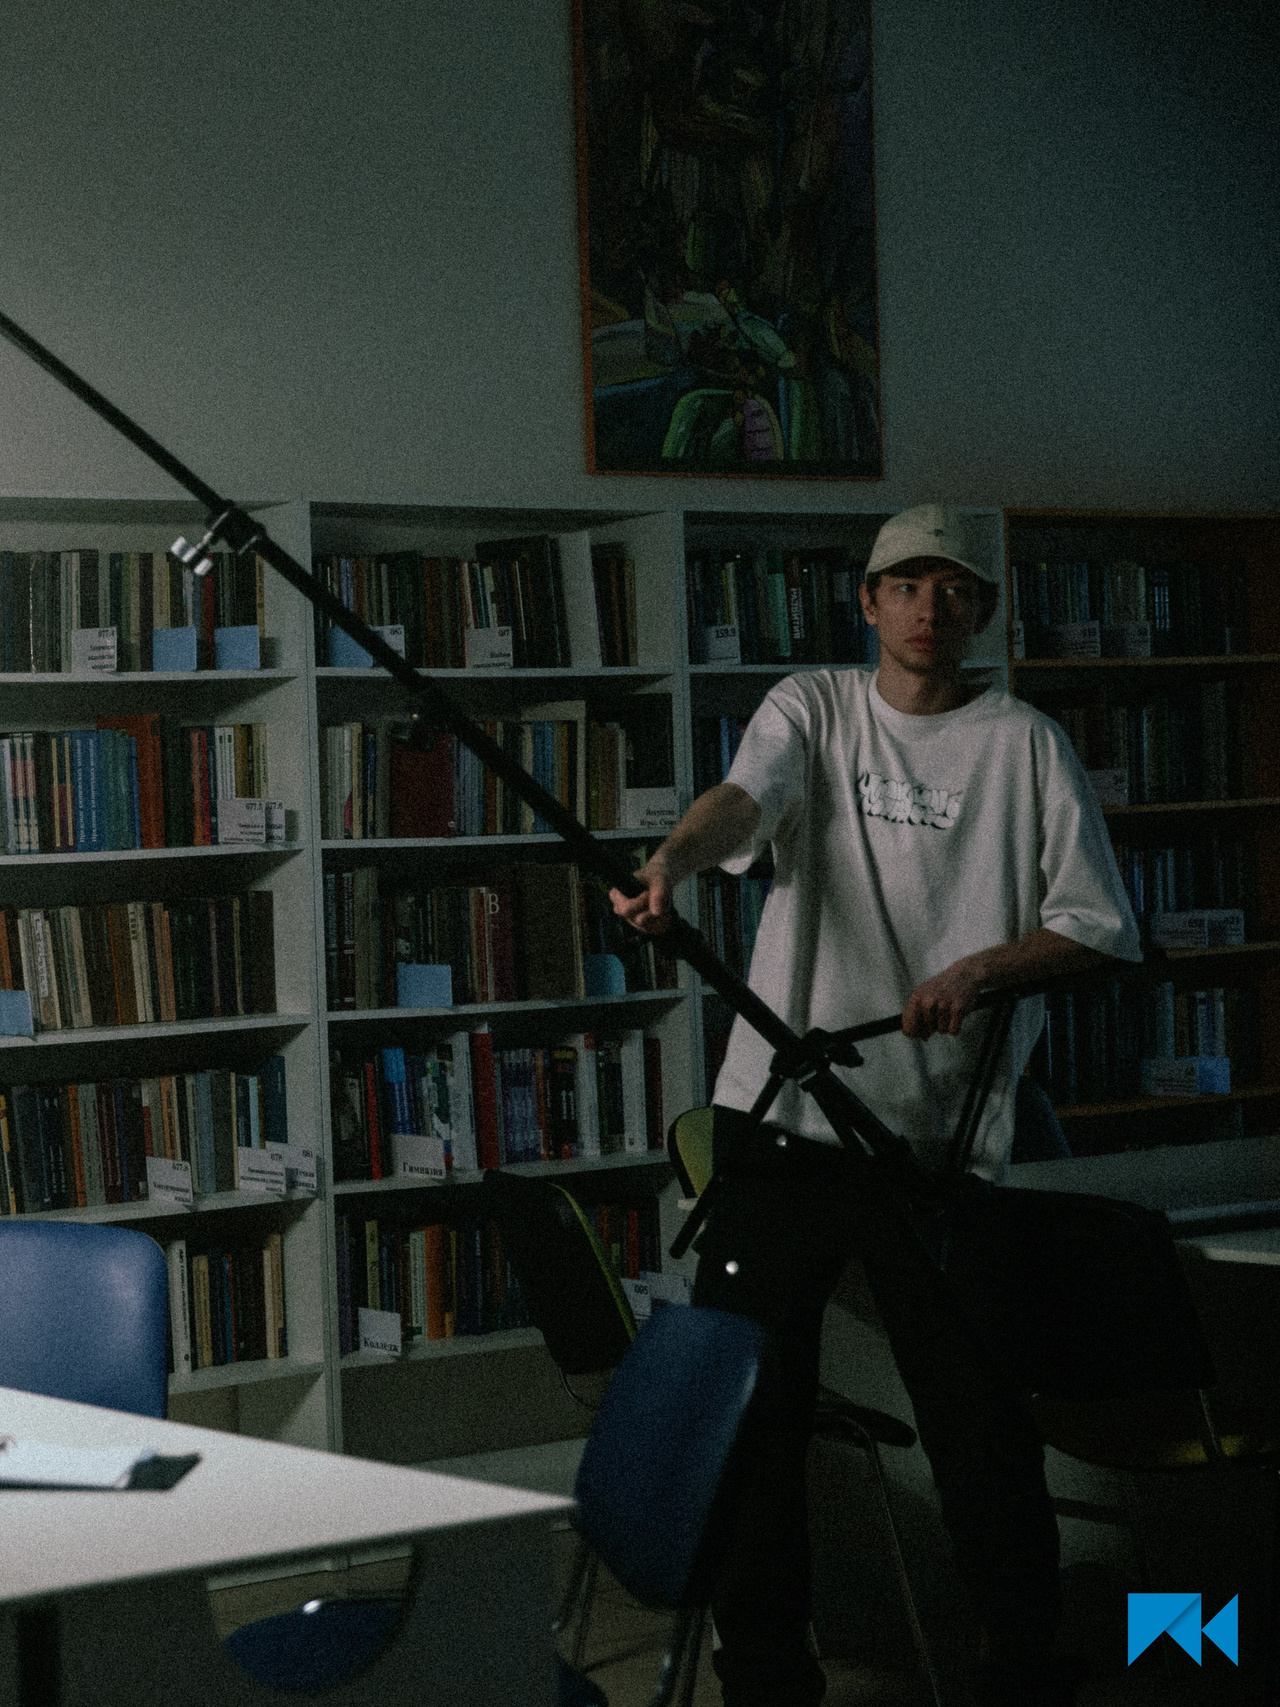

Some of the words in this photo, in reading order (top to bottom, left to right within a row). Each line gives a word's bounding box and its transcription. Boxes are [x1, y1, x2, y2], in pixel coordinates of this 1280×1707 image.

[715, 627, 737, 639] 159.9
[402, 1161, 444, 1177] Гимназия
[363, 1336, 400, 1353] Колледж
